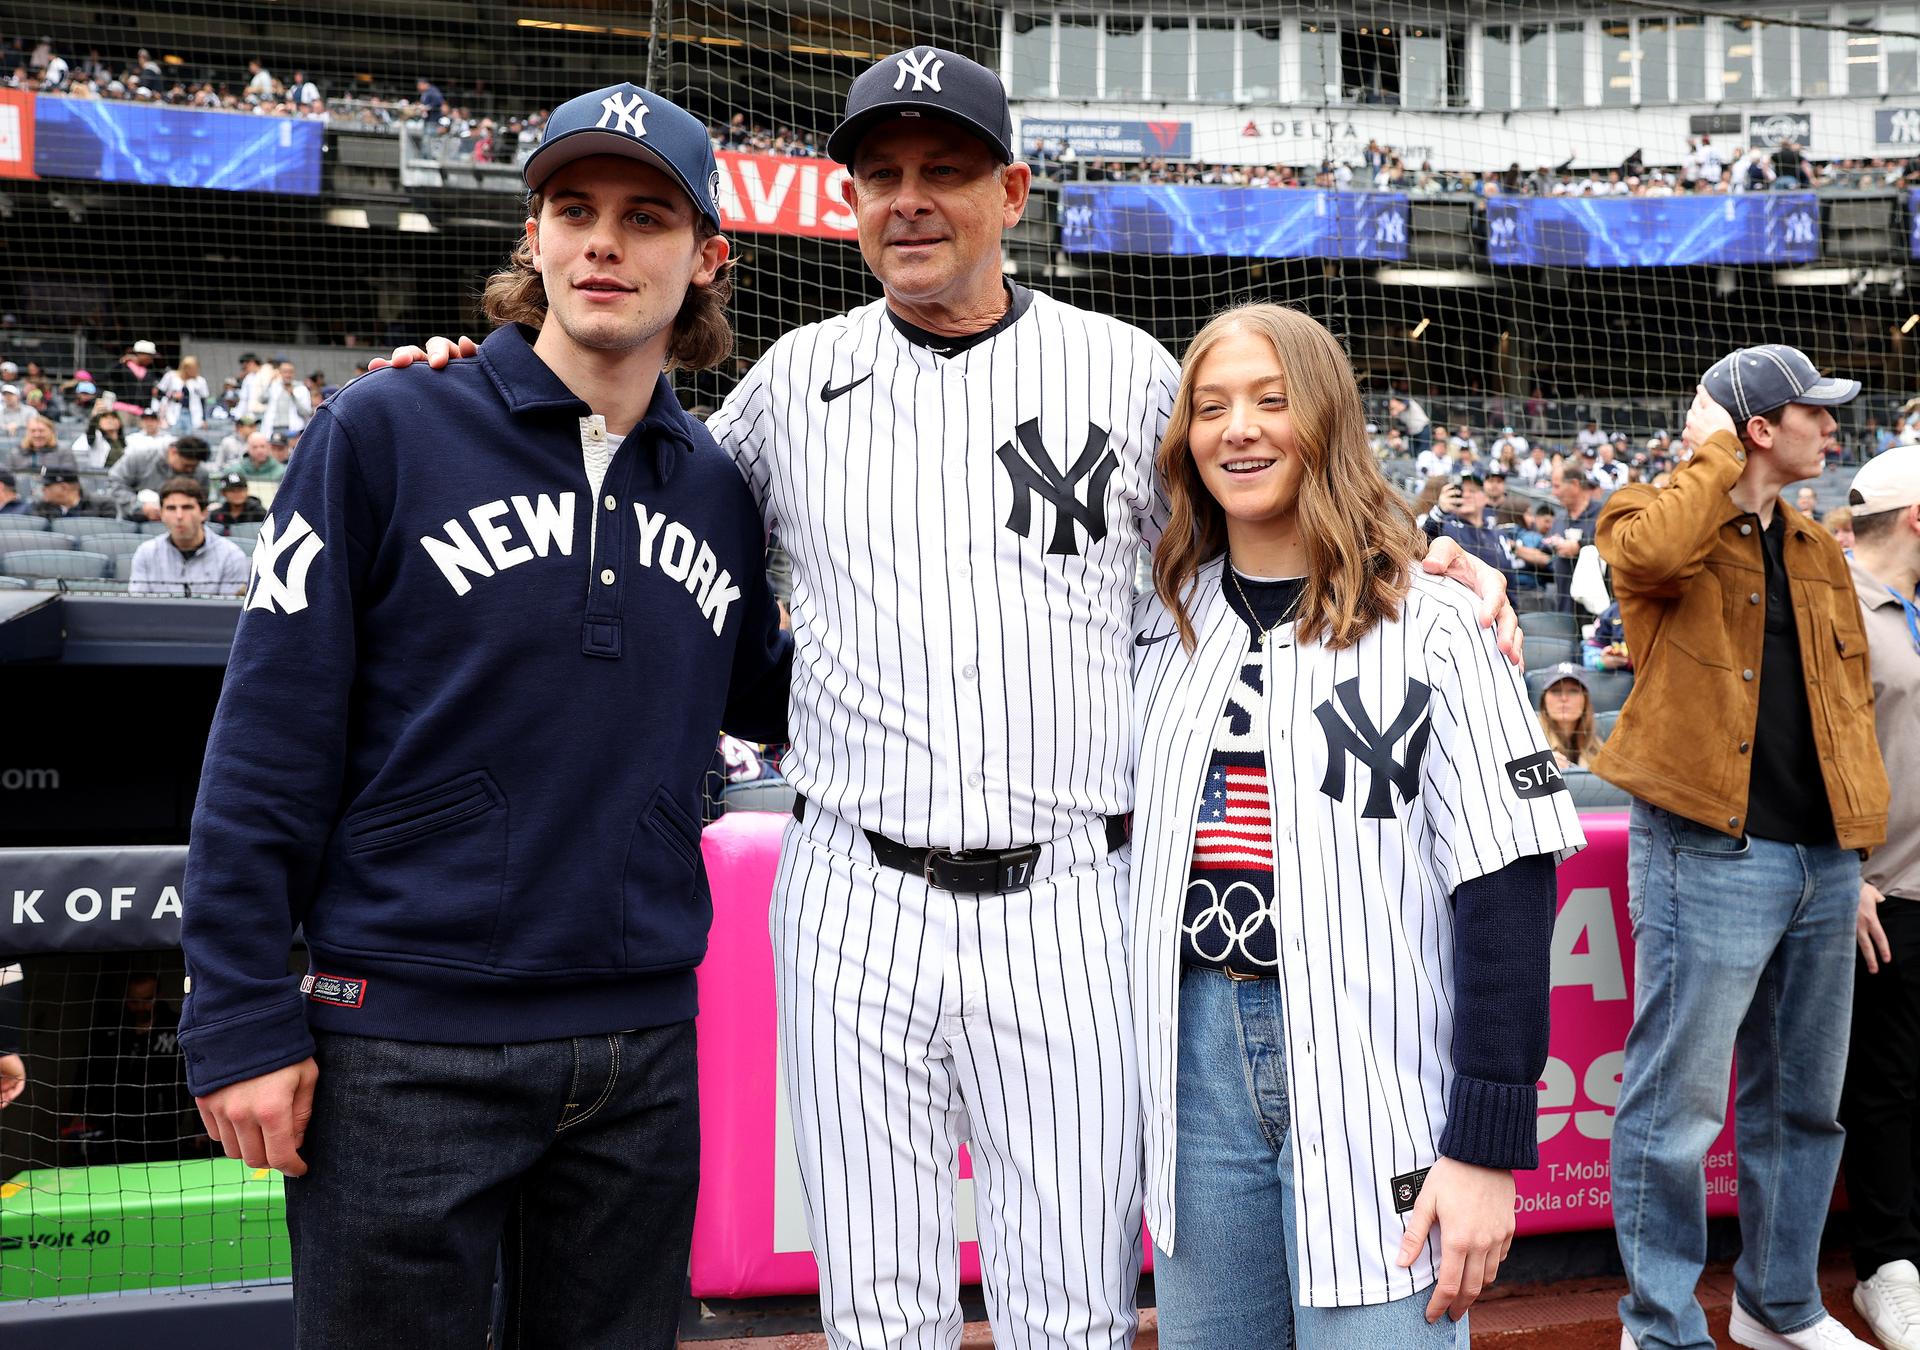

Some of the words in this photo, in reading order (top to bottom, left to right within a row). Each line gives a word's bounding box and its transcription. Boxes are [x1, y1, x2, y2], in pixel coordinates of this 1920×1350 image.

[893, 50, 945, 93] NY
[595, 91, 650, 138] NY
[1272, 121, 1358, 138] DELTA
[995, 417, 1120, 556] NY
[243, 510, 325, 615] NY
[420, 491, 576, 597] NEW
[633, 502, 741, 637] YORK
[1313, 676, 1433, 819] NY
[1514, 760, 1563, 791] STA
[1007, 862, 1029, 887] 17
[12, 889, 46, 924] K
[64, 887, 137, 922] OF
[151, 886, 183, 920] A
[1547, 1159, 1610, 1183] T-Mobi
[1514, 1192, 1562, 1213] Ookla
[1566, 1188, 1586, 1209] of
[1588, 1187, 1612, 1210] Sp
[82, 1229, 111, 1246] 40
